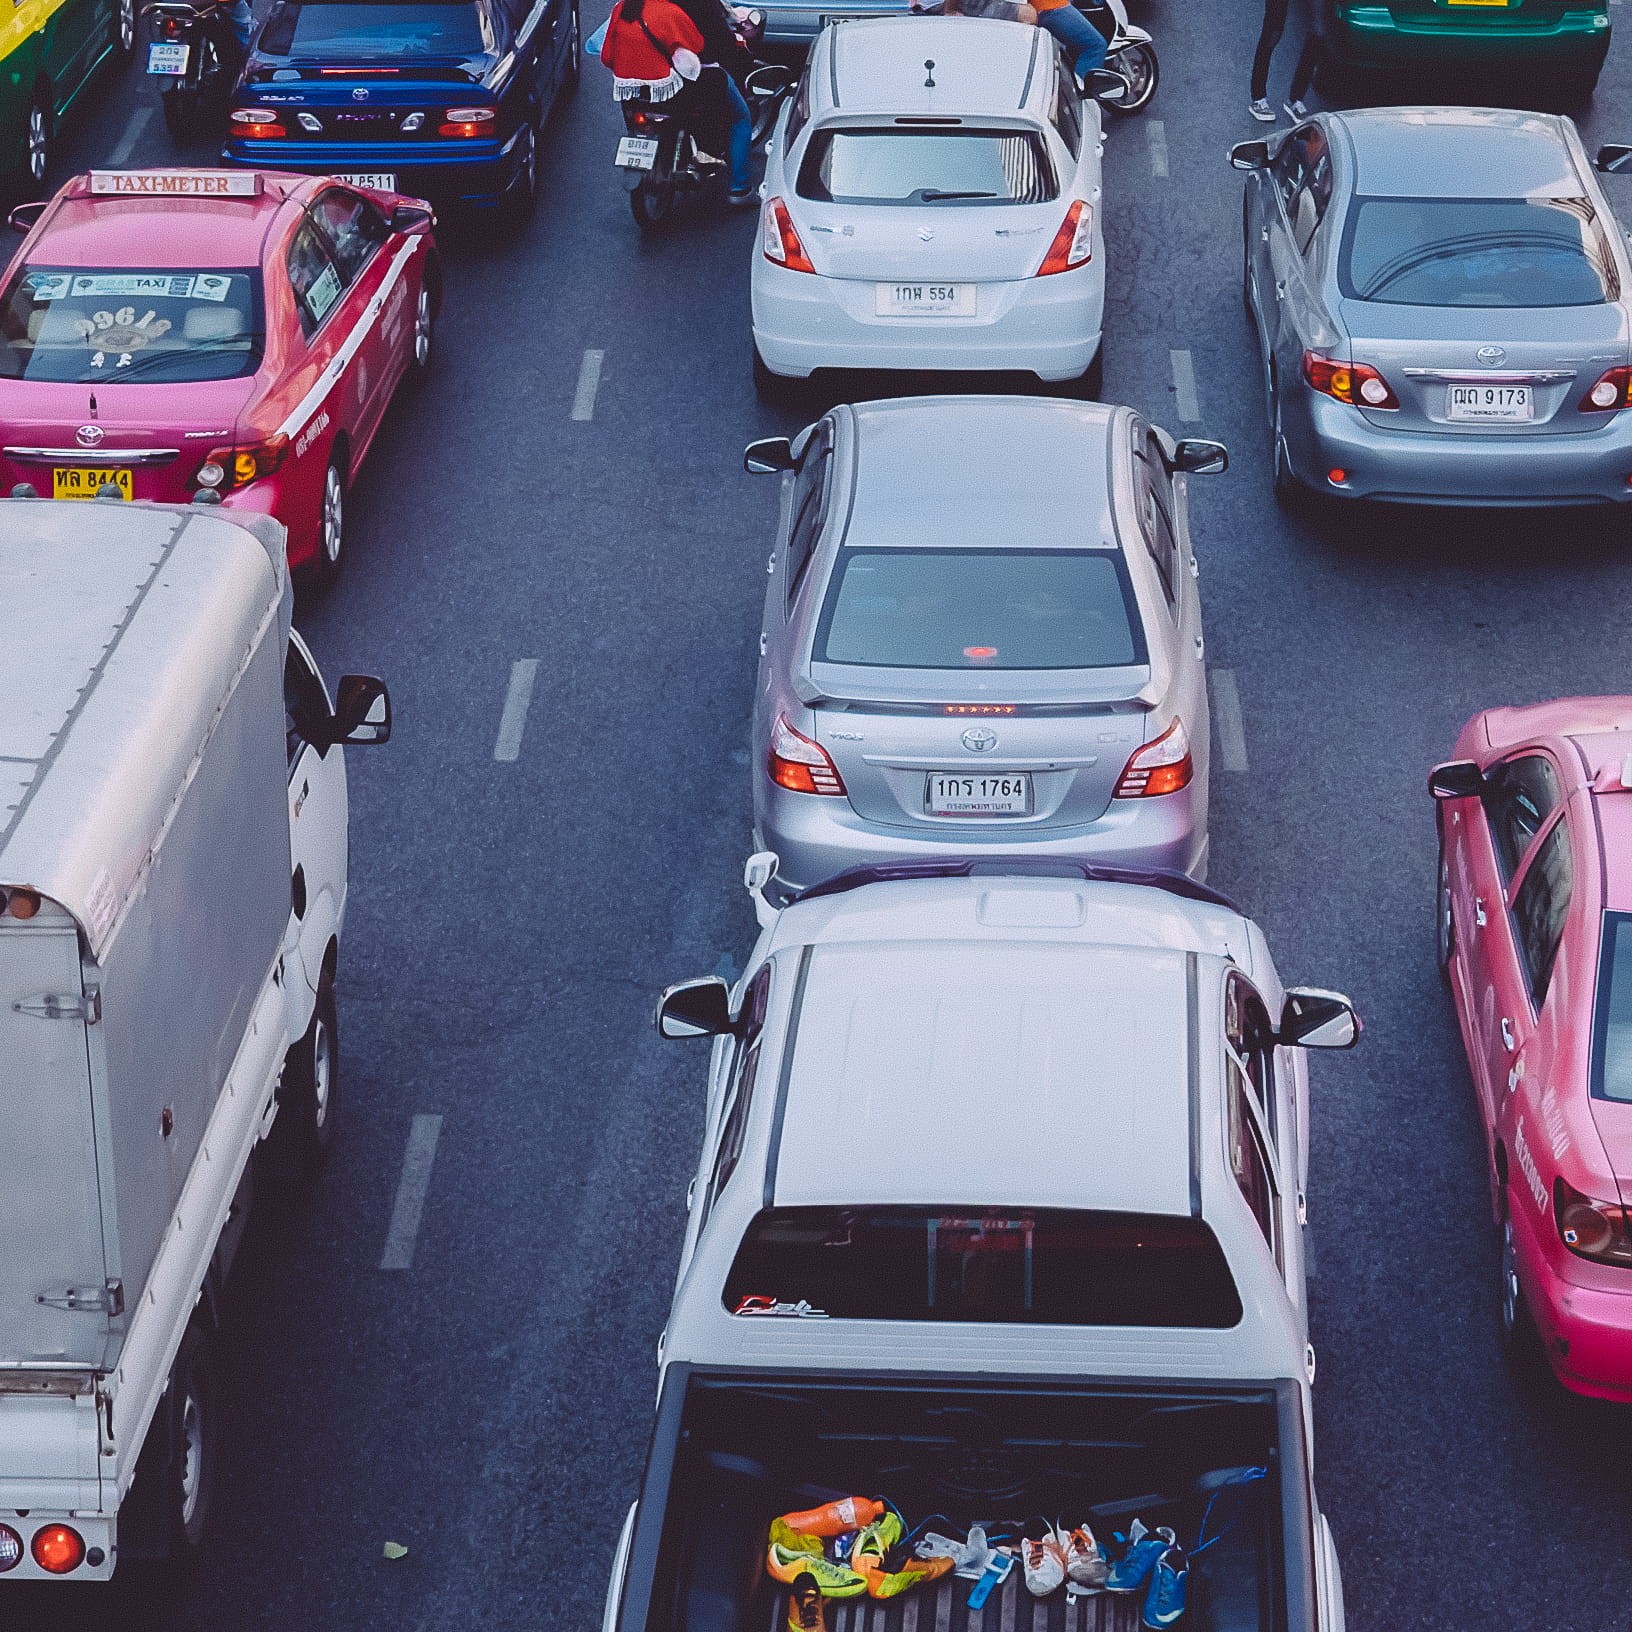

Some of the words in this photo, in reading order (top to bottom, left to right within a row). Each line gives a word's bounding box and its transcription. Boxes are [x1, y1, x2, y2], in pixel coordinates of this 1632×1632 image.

[112, 175, 230, 193] TAXI-METER
[930, 286, 956, 302] 554
[1485, 388, 1527, 406] 9173
[979, 778, 1024, 798] 1764
